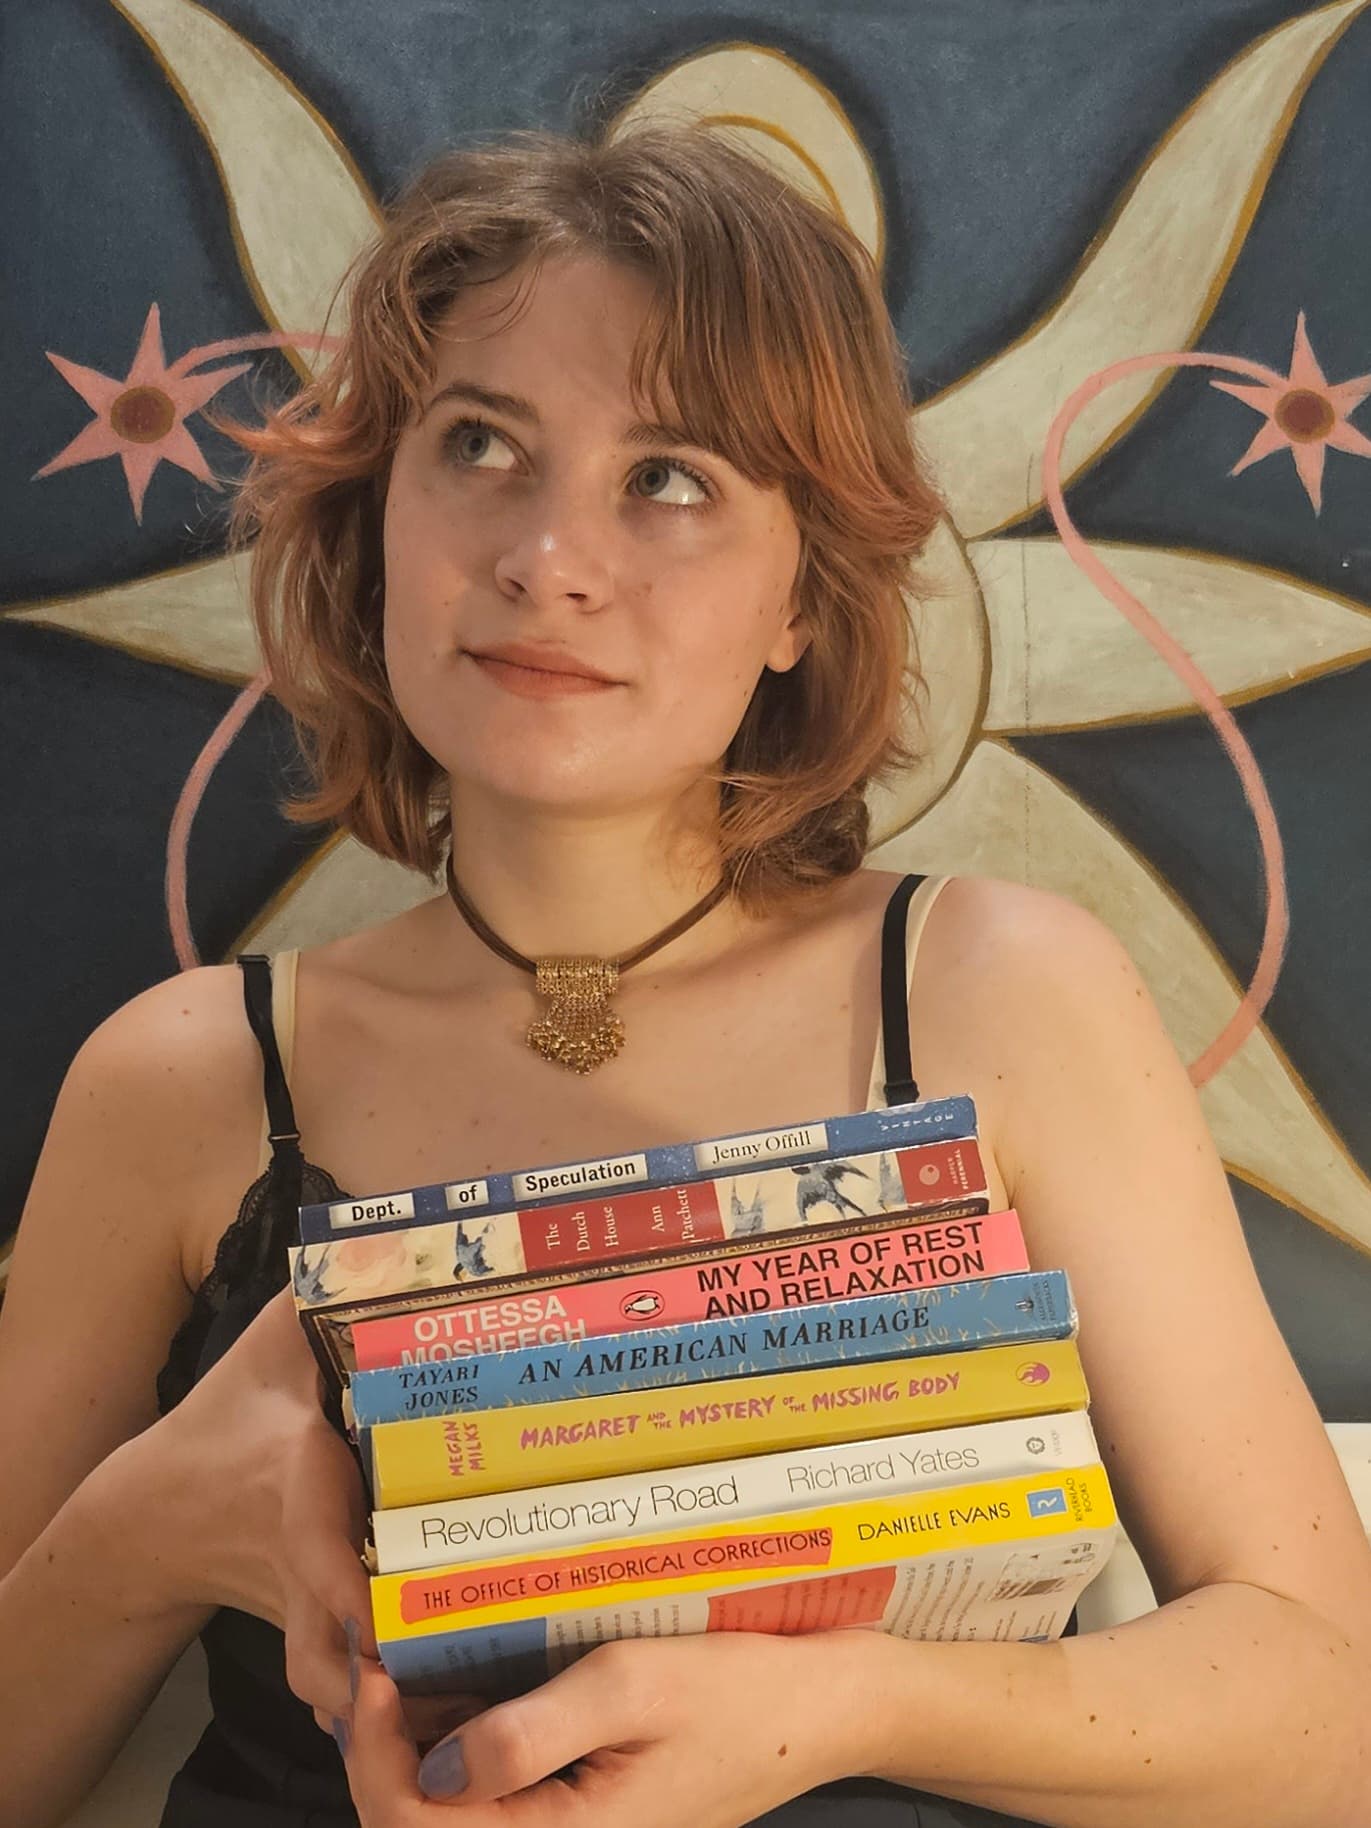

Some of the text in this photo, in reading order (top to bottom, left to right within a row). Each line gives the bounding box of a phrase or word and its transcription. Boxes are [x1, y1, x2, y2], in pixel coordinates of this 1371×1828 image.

[881, 1113, 954, 1131] VINTAGE
[712, 1130, 811, 1164] Jenny Offill
[351, 1161, 636, 1222] Dept. of Speculation
[571, 1211, 591, 1251] Dutch
[604, 1205, 619, 1247] House
[652, 1205, 665, 1232] Ann
[677, 1189, 695, 1240] Patchett
[545, 1223, 560, 1250] The
[697, 1222, 983, 1292] MY YEAR OF REST
[705, 1288, 770, 1320] AND
[781, 1250, 985, 1306] RELAXATION
[414, 1295, 567, 1342] OTTESSA
[518, 1306, 930, 1385] AN AMERICAN MARRIAGE
[399, 1364, 479, 1389] TAYARI
[812, 1372, 960, 1413] MISSING BODY
[405, 1386, 478, 1411] JONES
[647, 1411, 666, 1422] AND
[680, 1394, 776, 1428] MYSTERY
[782, 1396, 795, 1406] OF
[789, 1403, 807, 1413] THE
[520, 1414, 641, 1450] MARGARET
[653, 1420, 672, 1430] THE
[443, 1420, 464, 1476] MEGAN
[463, 1422, 486, 1471] MILKS
[786, 1448, 981, 1493] Richard Yates
[421, 1475, 739, 1549] Revolutionary Road
[1079, 1483, 1093, 1512] BOOKS
[858, 1502, 1011, 1541] DANIELLE EVANS
[424, 1530, 831, 1610] THE OFFICE OF HISTORICAL CORRECTIONS
